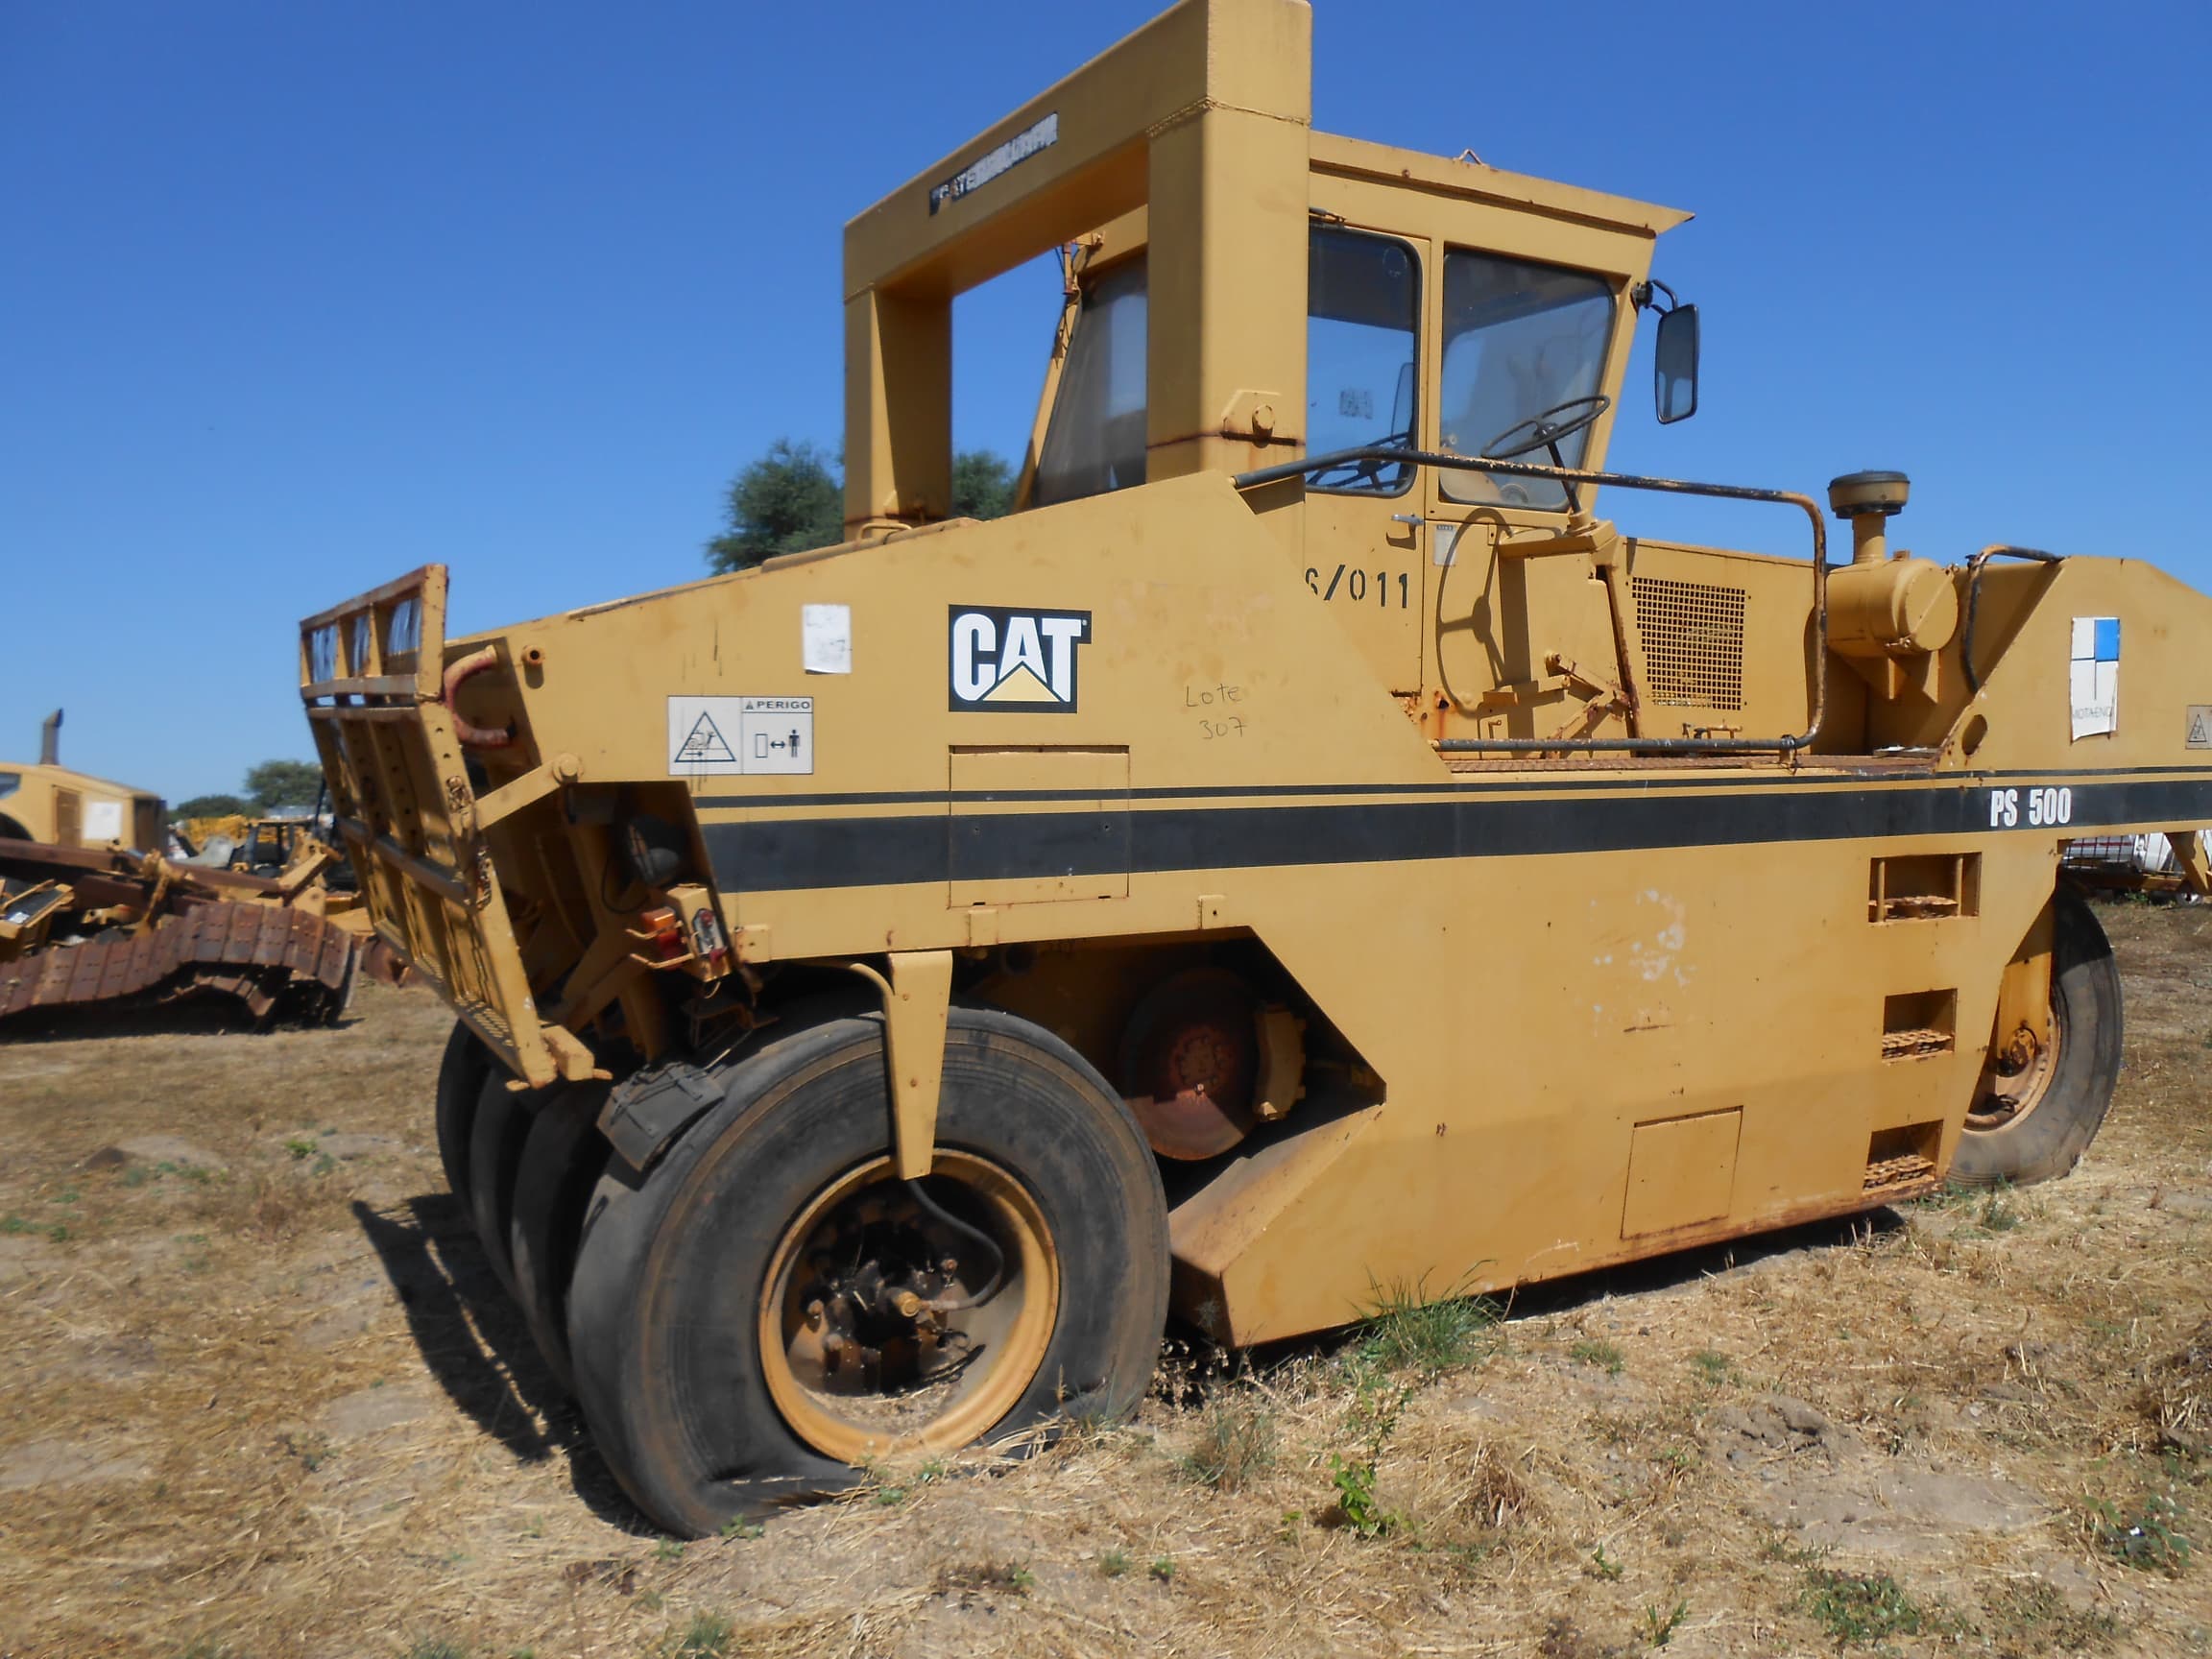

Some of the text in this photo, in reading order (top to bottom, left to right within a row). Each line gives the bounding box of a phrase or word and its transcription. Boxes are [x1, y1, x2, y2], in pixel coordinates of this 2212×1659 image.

[952, 613, 1082, 703] CAT
[757, 700, 811, 709] PERIGO
[1199, 716, 1247, 739] 307
[1990, 788, 2072, 827] PS 500
